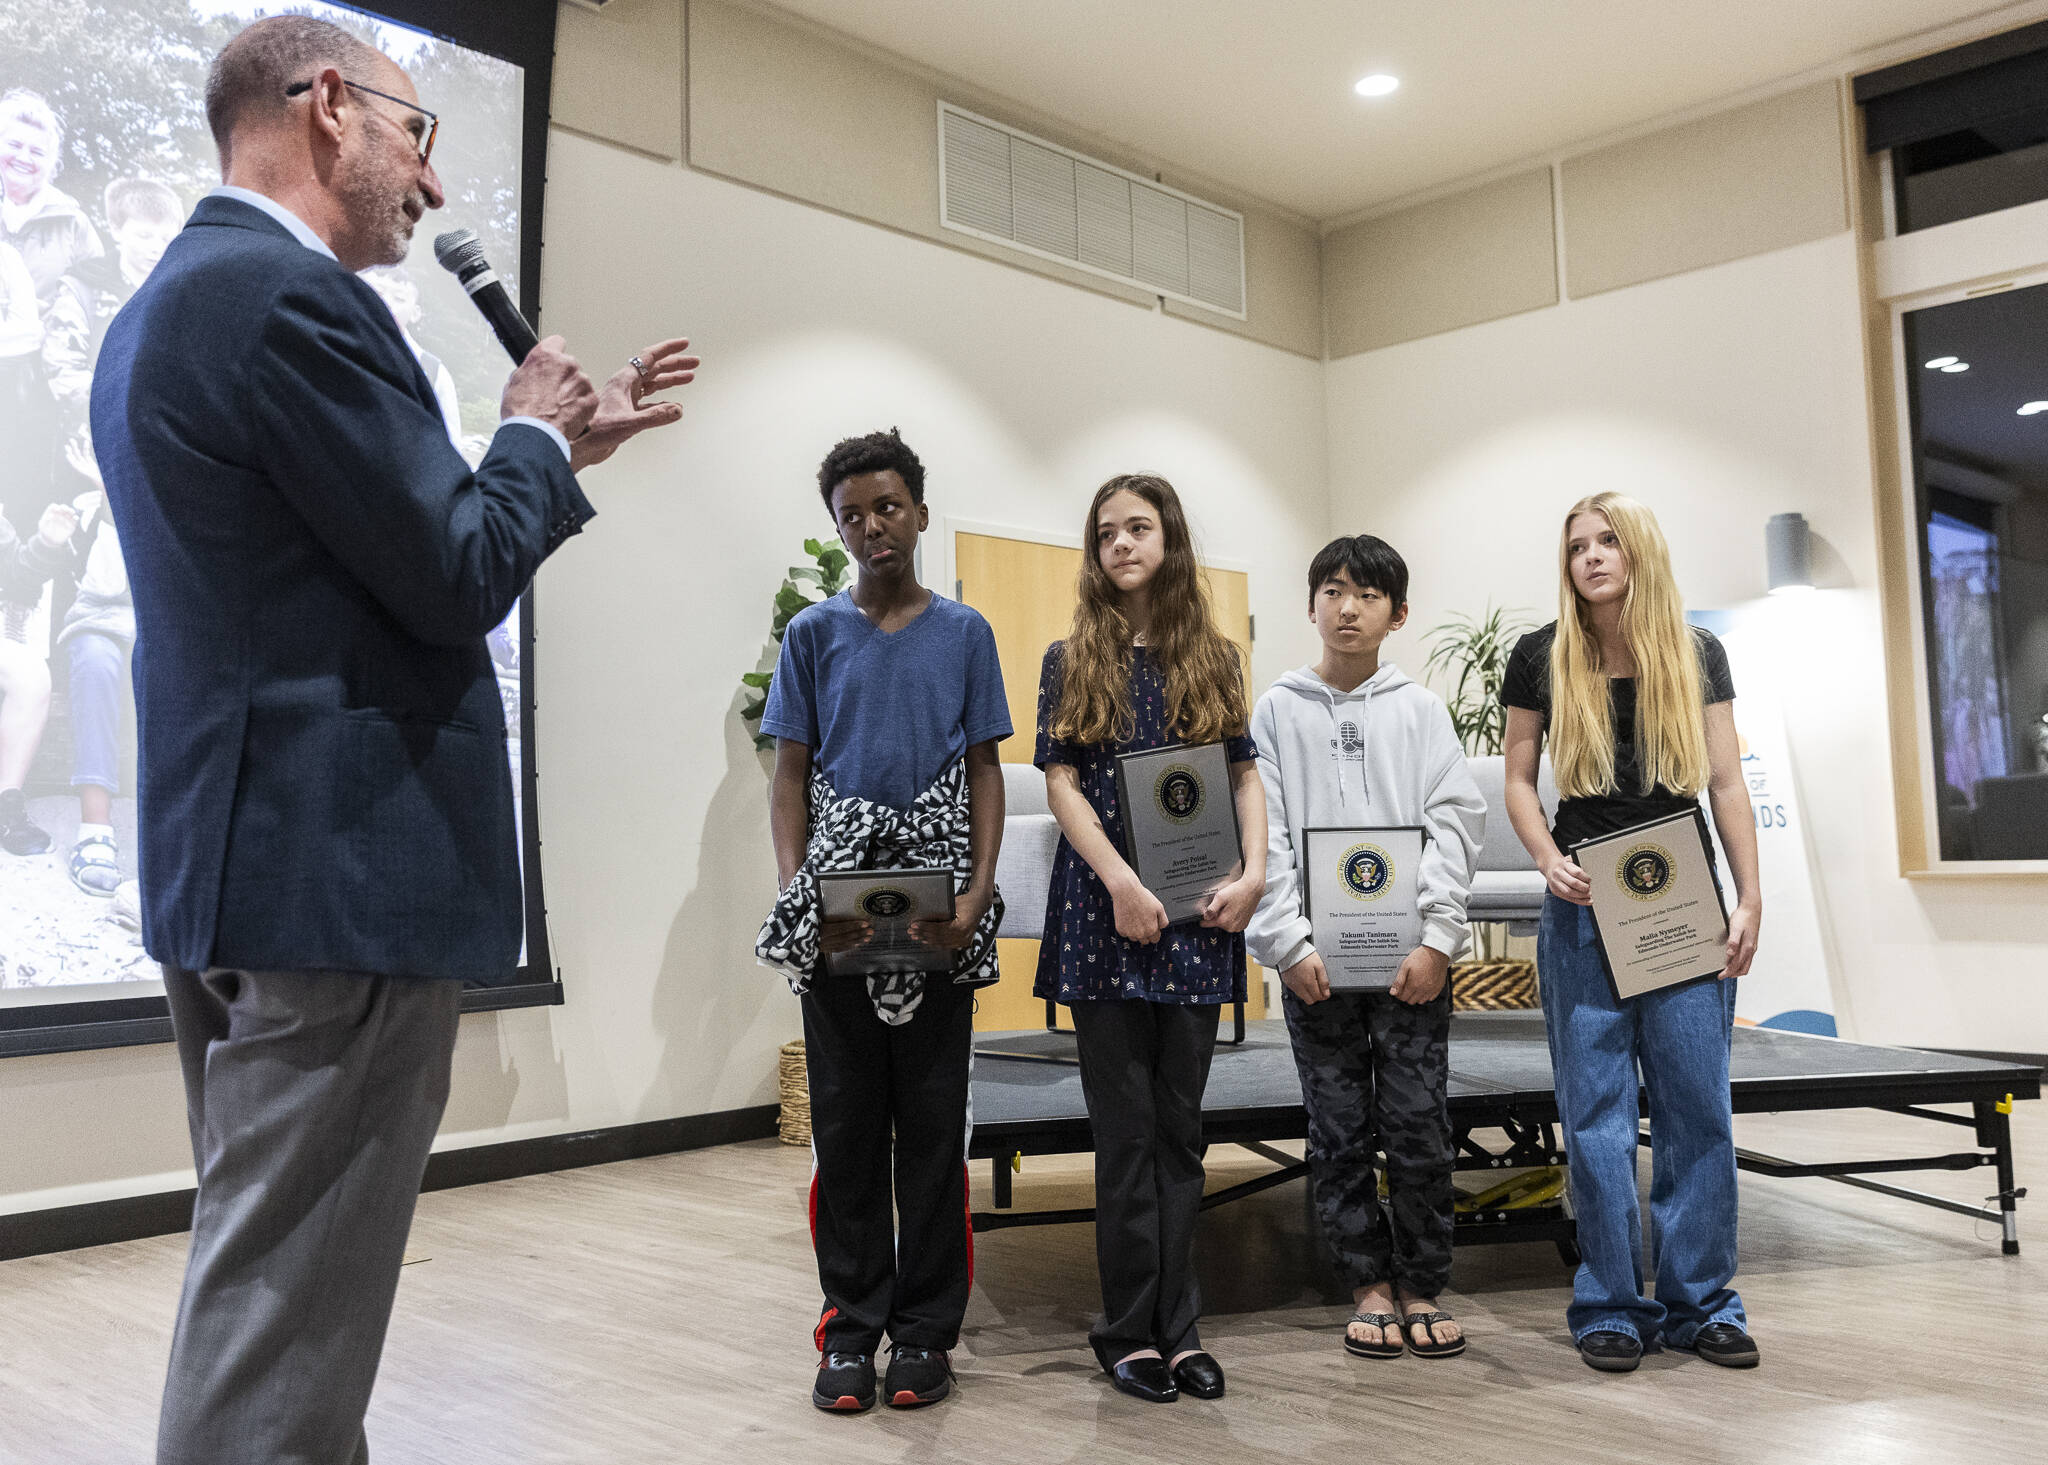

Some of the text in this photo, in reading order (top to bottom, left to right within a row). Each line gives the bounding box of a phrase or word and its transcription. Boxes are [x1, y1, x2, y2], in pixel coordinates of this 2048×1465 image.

[1750, 779, 1767, 790] OF
[1172, 857, 1190, 867] Avery
[1339, 845, 1364, 871] PRESIDENT
[1617, 847, 1638, 879] PRESIDENT
[1629, 914, 1651, 924] President
[1683, 900, 1698, 908] States
[1659, 924, 1688, 936] Nymeyer
